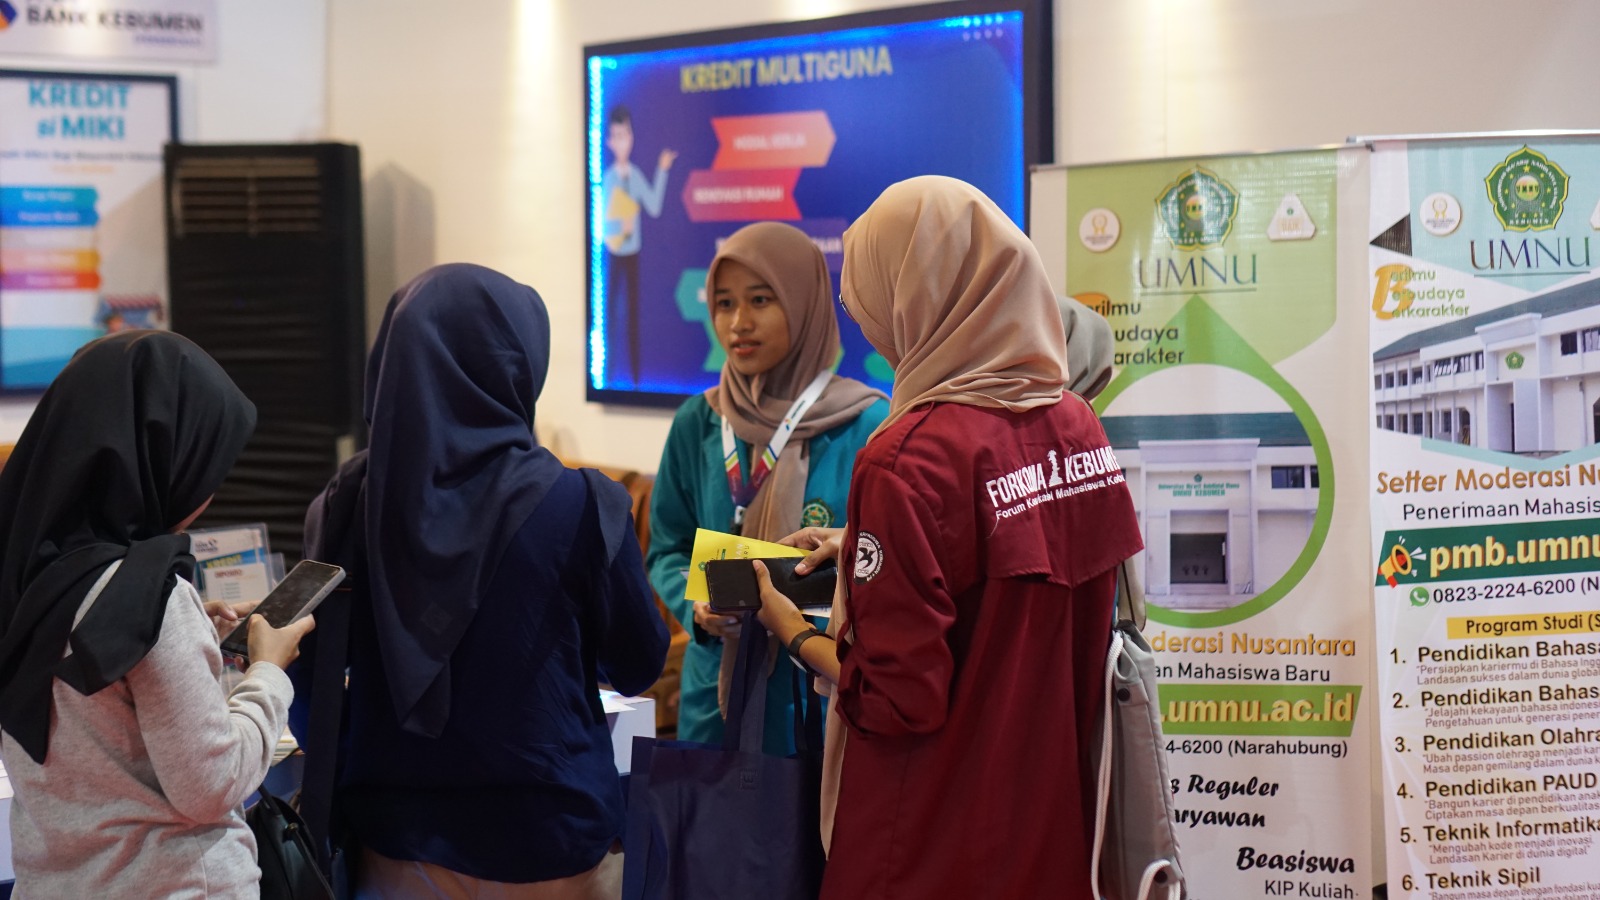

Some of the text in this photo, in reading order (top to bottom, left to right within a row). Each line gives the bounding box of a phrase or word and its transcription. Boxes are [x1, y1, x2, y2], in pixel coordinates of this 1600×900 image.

[98, 12, 204, 32] KEBUMEN
[680, 46, 893, 93] KREDIT MULTIGUNA
[28, 80, 132, 108] KREDIT
[61, 115, 126, 140] MIKI
[1471, 237, 1590, 270] UMNU
[1139, 254, 1257, 289] UMNU
[1086, 300, 1142, 317] rilmu
[1376, 464, 1600, 494] Setter Moderasi N
[995, 502, 1026, 521] Forum
[1056, 480, 1106, 500] Mahasiswa
[1403, 496, 1600, 521] Penerimaan Mahasis
[1433, 578, 1575, 603] 0823-2224-6200
[1466, 618, 1538, 637] Program
[1543, 614, 1583, 630] Studi
[1145, 630, 1356, 656] derasi Nusantara
[1390, 640, 1600, 664] 1. Pendidikan Bahas
[1178, 662, 1280, 681] Mahasiswa
[1286, 665, 1331, 682] Baru
[1530, 660, 1539, 669] di
[1541, 658, 1578, 668] Bahasa
[1417, 675, 1468, 685] Landasan
[1470, 672, 1506, 682] sukses
[1508, 671, 1540, 681] dalam
[1542, 669, 1570, 679] dunia
[1393, 692, 1410, 708] 2.
[1421, 687, 1532, 707] Pendidikan
[1471, 704, 1519, 716] kekayaan
[1521, 702, 1558, 713] bahasa
[1425, 717, 1493, 729] Pengetahuan
[1495, 714, 1524, 725] untuk
[1526, 711, 1570, 725] generasi
[1228, 740, 1348, 758] (Narahubung)
[1395, 736, 1412, 752] 3.
[1423, 731, 1534, 751] Pendidikan
[1423, 764, 1451, 774] Masa
[1453, 761, 1484, 774] depan
[1486, 760, 1531, 773] gemilang
[1534, 758, 1565, 768] dalam
[1567, 756, 1593, 766] dunia
[1455, 751, 1494, 763] passion
[1543, 746, 1582, 758] menjadi
[1187, 774, 1280, 800] Reguler
[1397, 772, 1597, 799] 4. Pendidikan PAUD
[1472, 797, 1505, 807] karier
[1507, 795, 1517, 805] di
[1519, 792, 1576, 806] pendidikan
[1425, 808, 1473, 821] Ciptakan
[1475, 807, 1504, 817] masa
[1507, 805, 1539, 817] depan
[1400, 827, 1417, 843] 5.
[1423, 822, 1490, 841] Teknik
[1488, 841, 1513, 851] kode
[1514, 838, 1555, 850] menjadi
[1236, 847, 1355, 873] Beasiswa
[1429, 853, 1480, 864] Landasan
[1516, 849, 1525, 859] di
[1527, 848, 1555, 859] dunia
[1265, 880, 1294, 896] KIP
[1402, 866, 1541, 891] 6. Teknik Sipil
